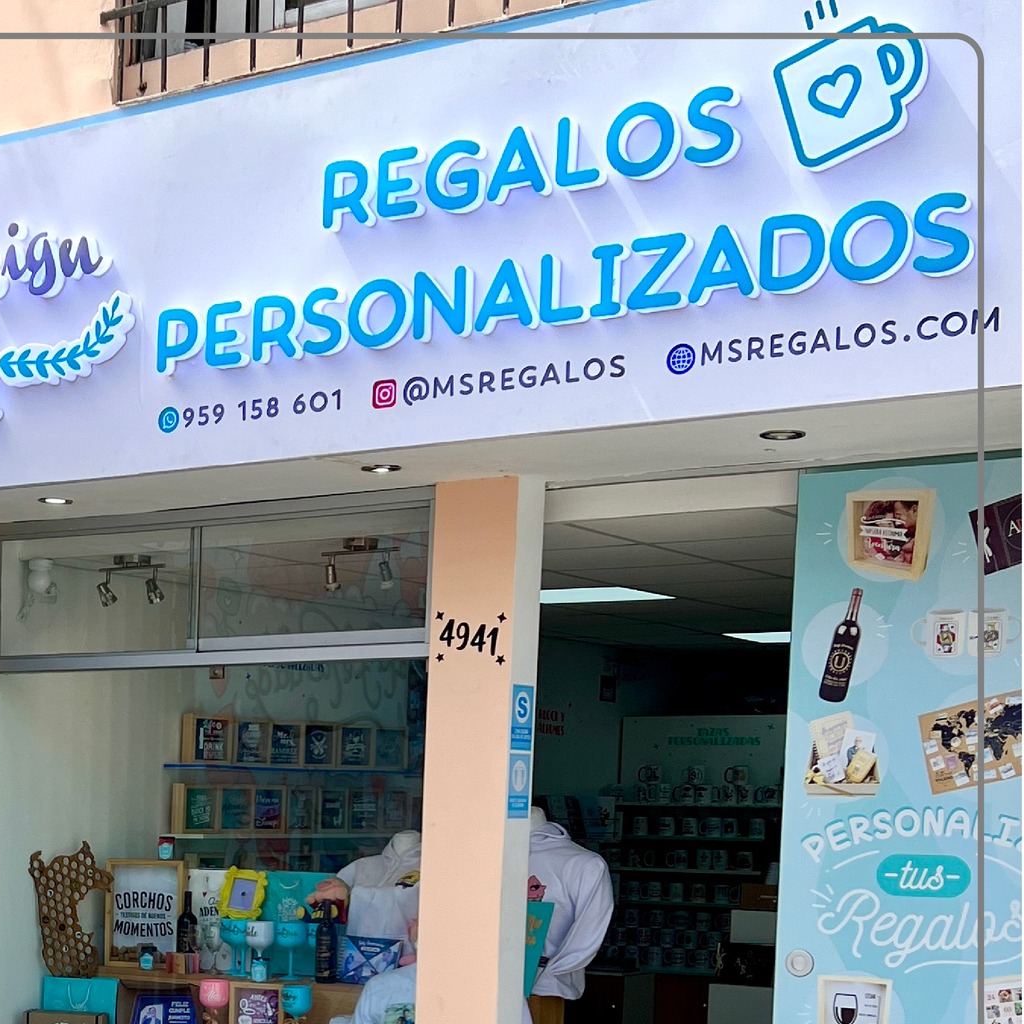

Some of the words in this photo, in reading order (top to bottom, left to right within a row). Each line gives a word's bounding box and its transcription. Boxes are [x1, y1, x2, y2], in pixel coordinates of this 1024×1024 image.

[323, 86, 736, 230] REGALOS
[156, 192, 971, 373] PERSONALIZADOS
[181, 403, 225, 428] 959
[237, 396, 280, 422] 158
[293, 388, 342, 414] 601
[403, 354, 627, 407] @MSREGALOS
[700, 306, 1000, 366] MSREGALOS.COM
[438, 618, 500, 656] 4941
[517, 696, 528, 719] S
[800, 805, 1023, 864] PERSONALI
[115, 891, 174, 912] CORCHOS
[114, 919, 174, 938] MOMENTOS
